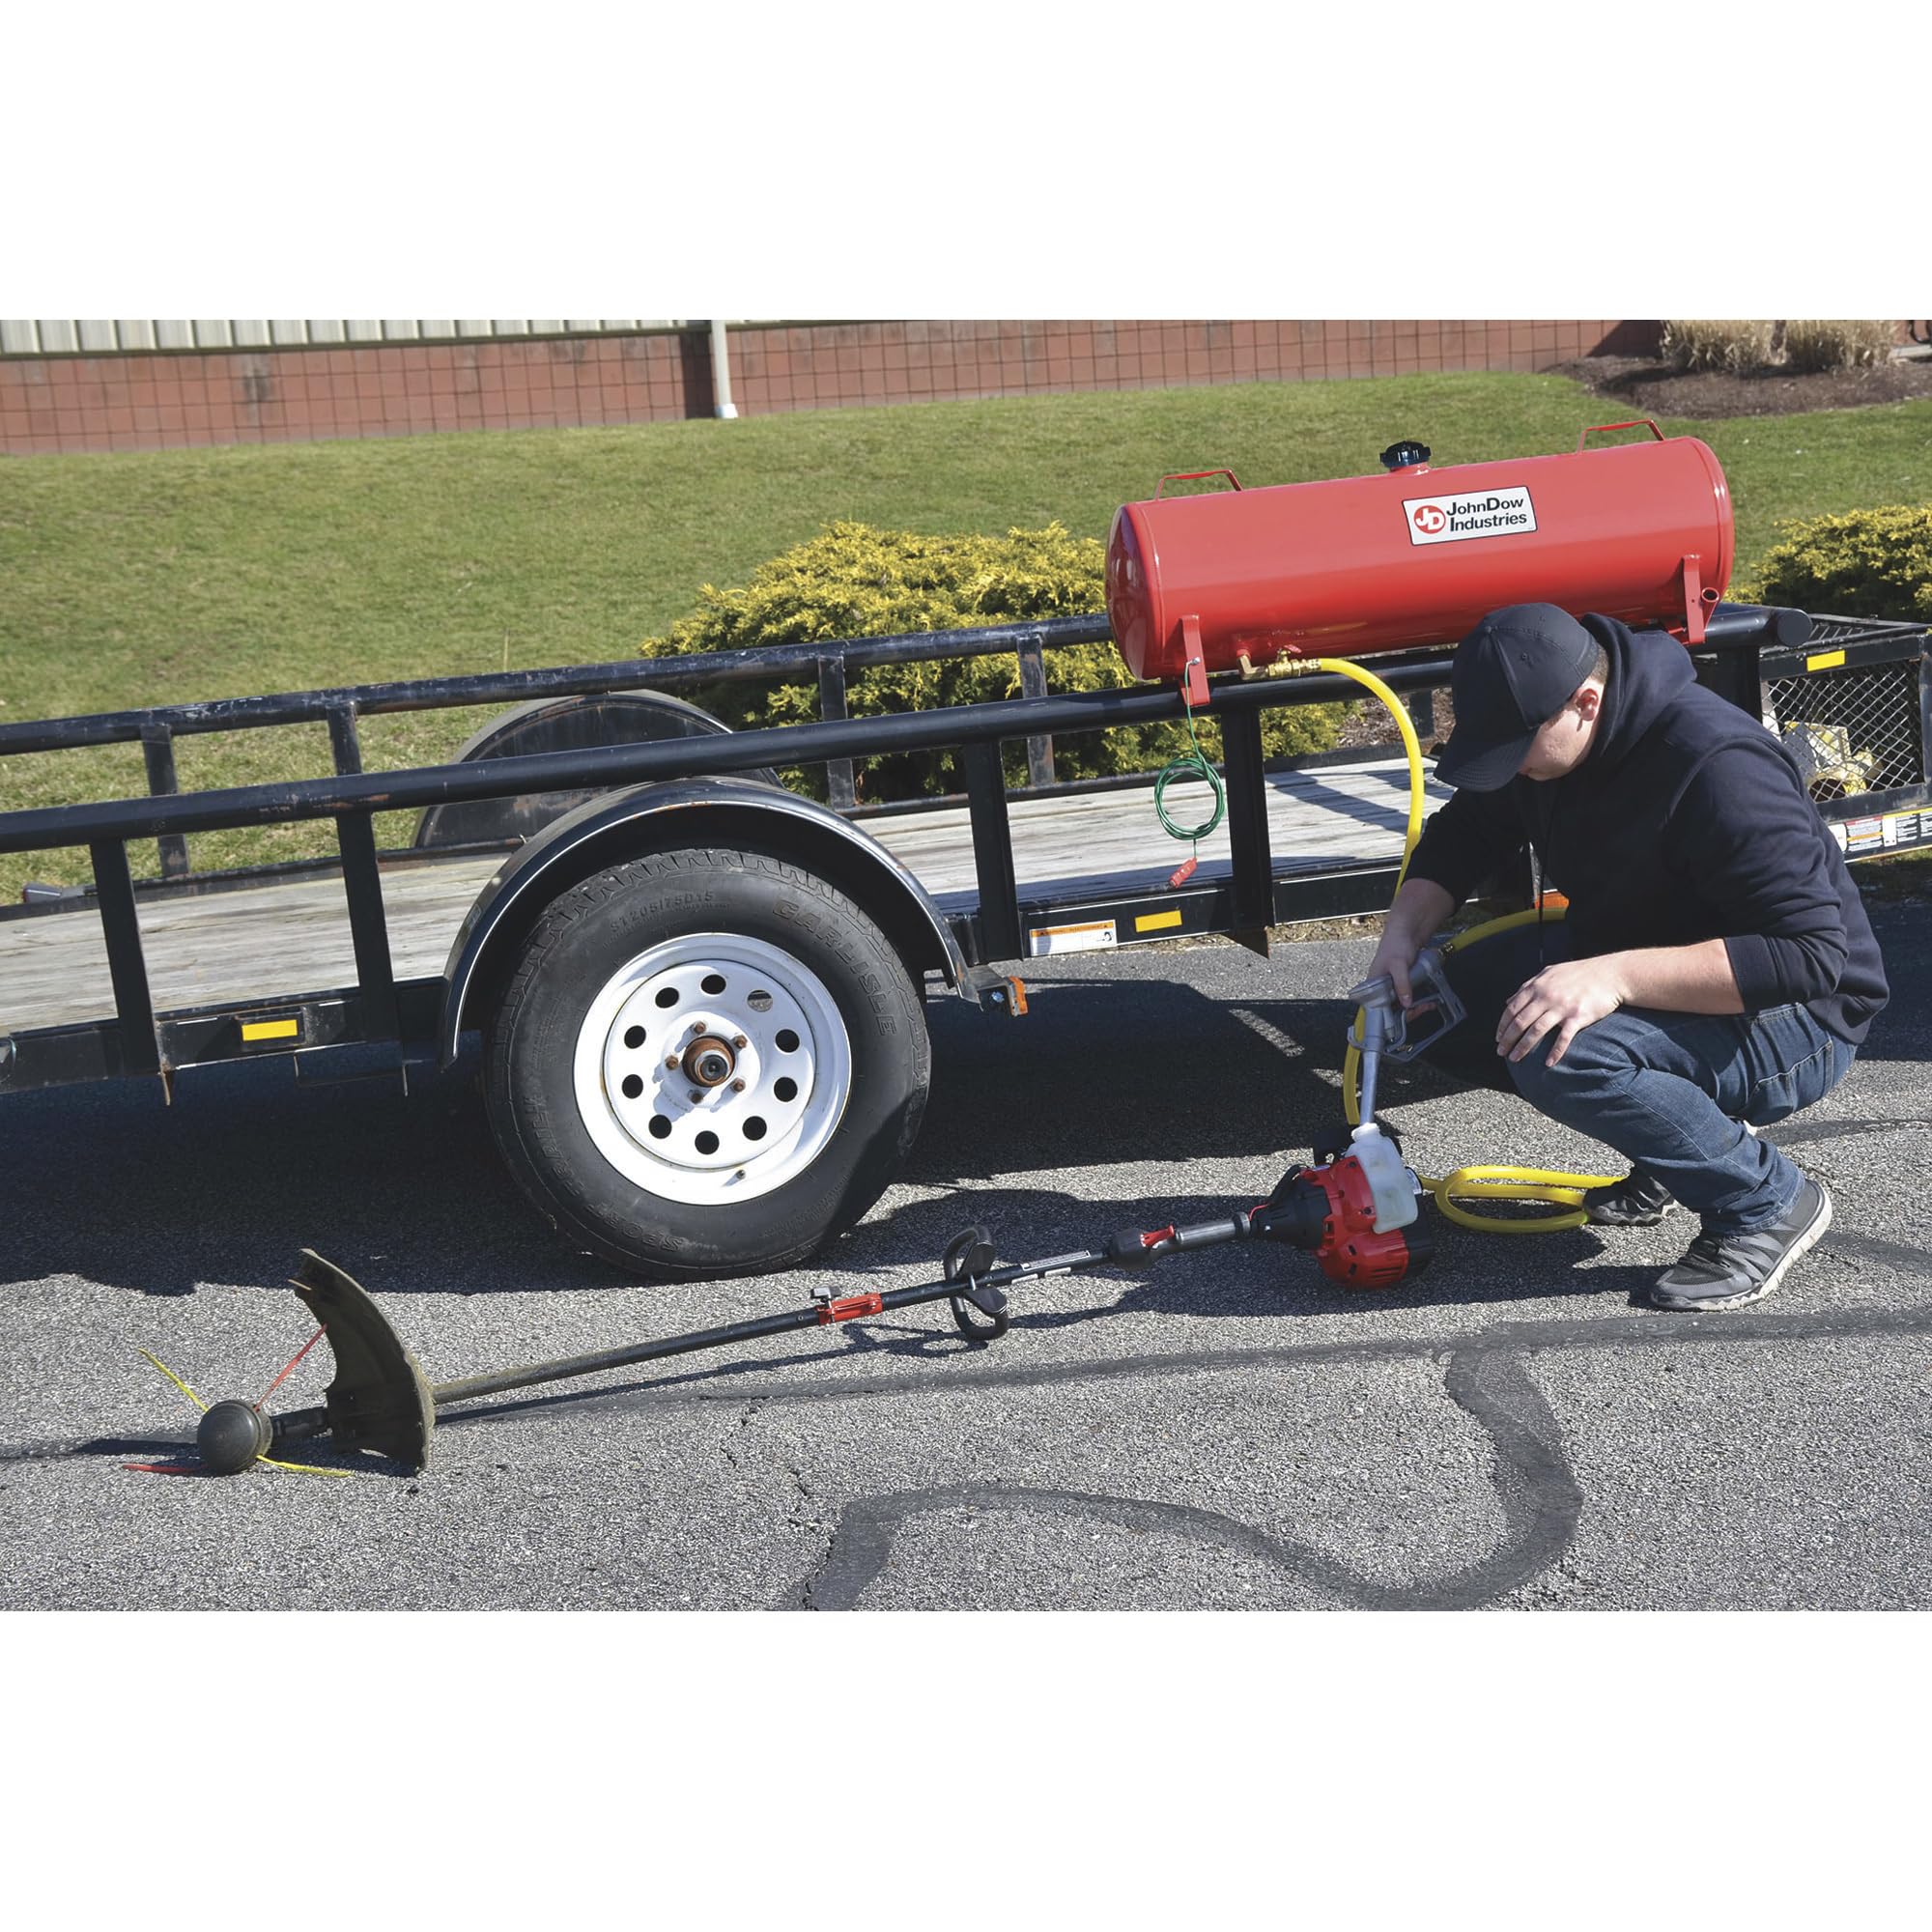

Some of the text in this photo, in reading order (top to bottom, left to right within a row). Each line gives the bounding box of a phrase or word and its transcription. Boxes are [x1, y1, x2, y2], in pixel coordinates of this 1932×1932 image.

[1446, 497, 1523, 516] JohnDow
[1415, 507, 1445, 531] JD
[1449, 512, 1527, 532] Industries
[772, 898, 897, 1037] CARLISLE
